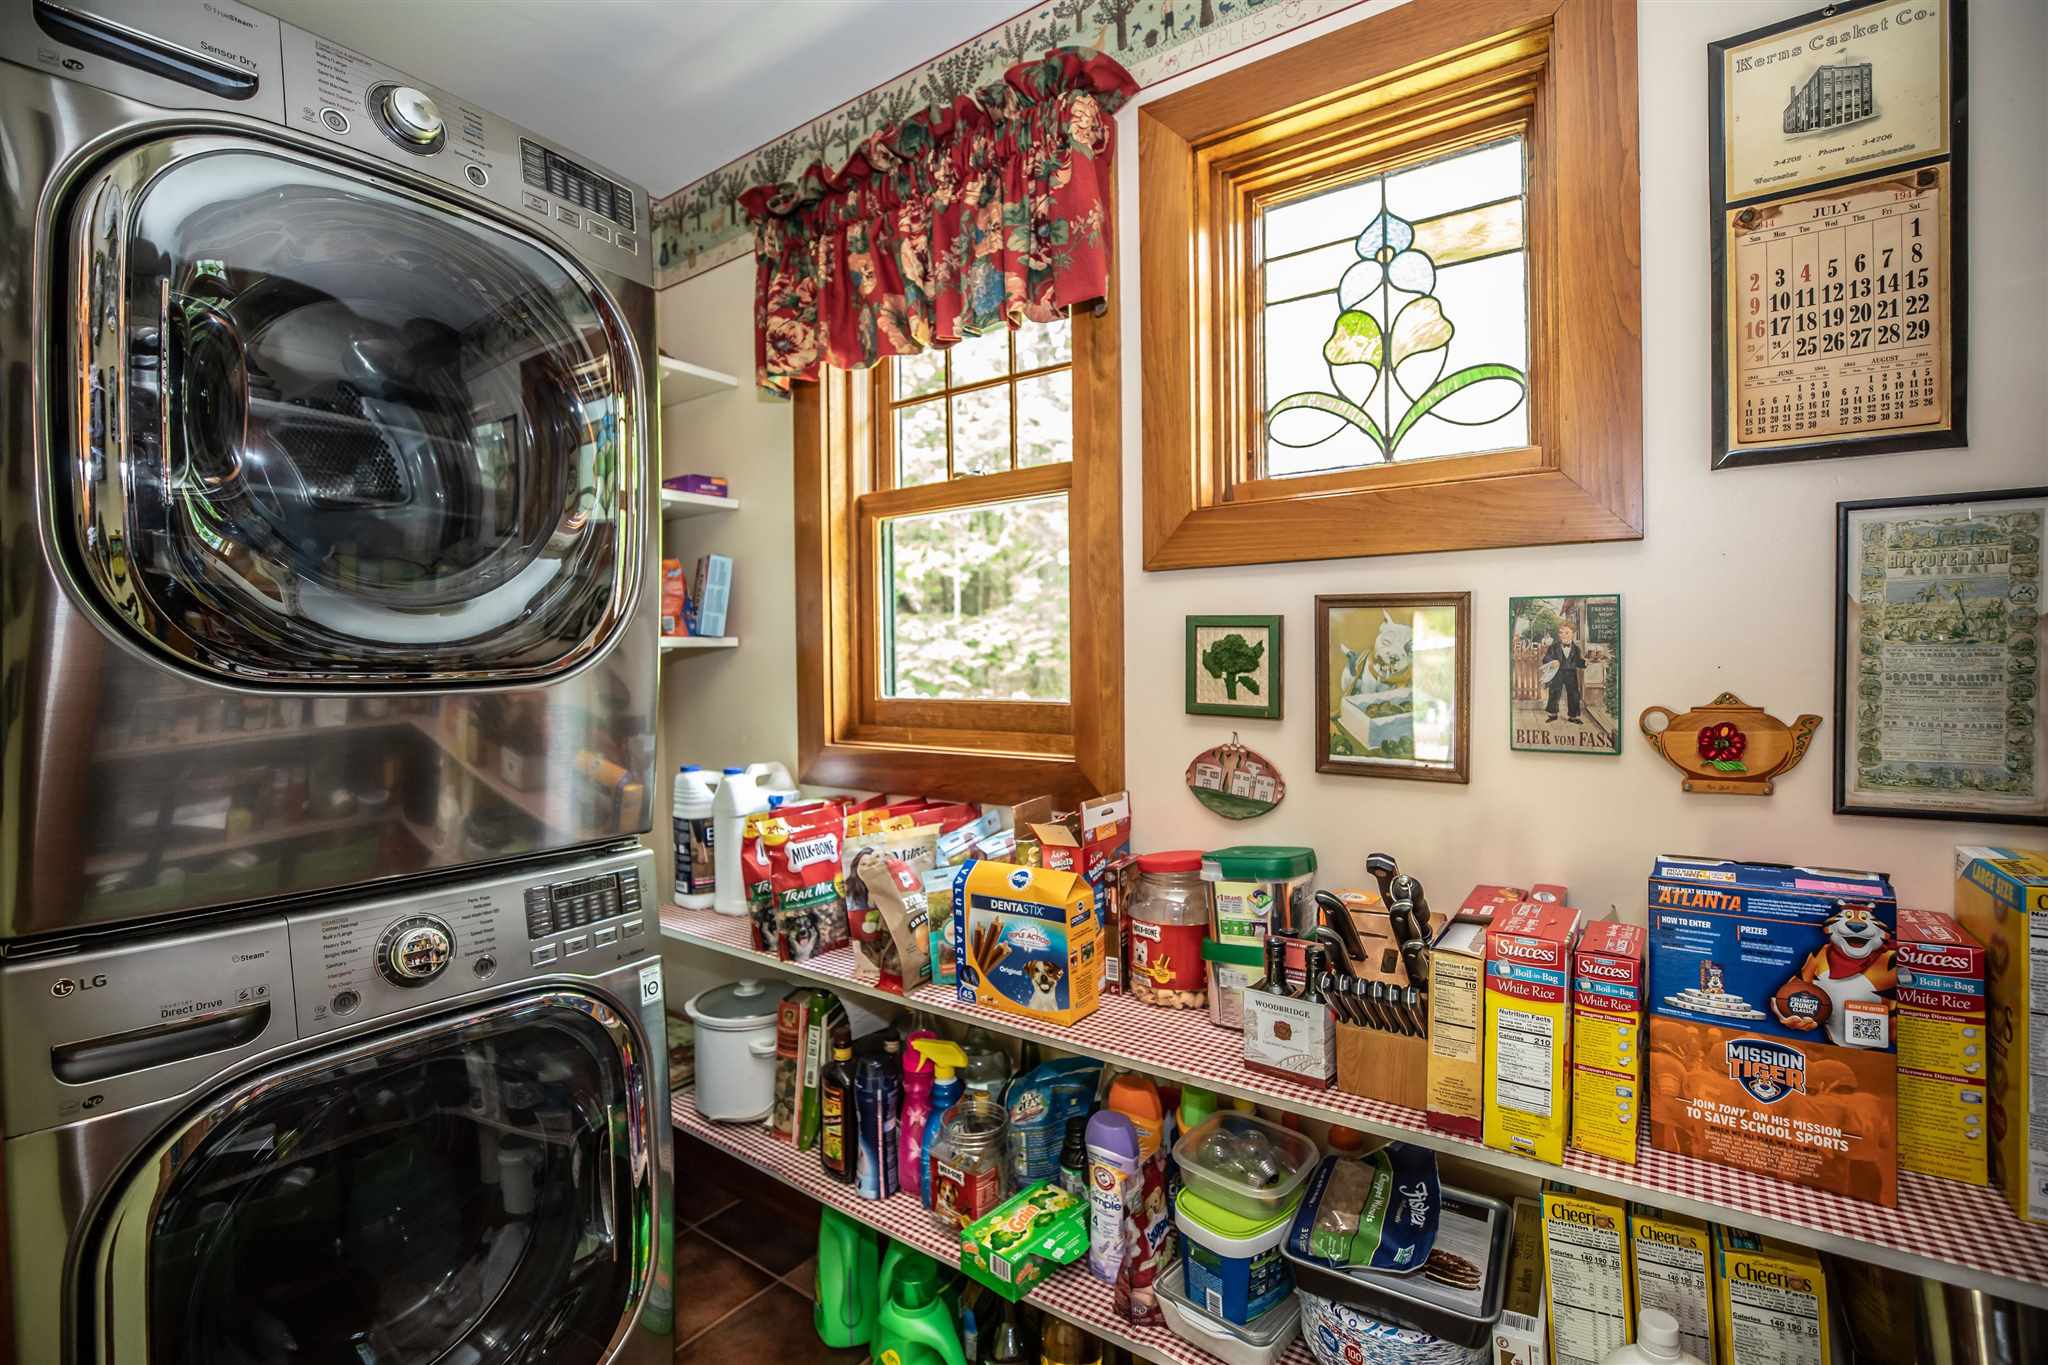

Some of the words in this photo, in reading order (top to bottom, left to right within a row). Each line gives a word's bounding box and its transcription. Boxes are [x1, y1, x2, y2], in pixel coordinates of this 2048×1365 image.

[1808, 17, 1889, 51] Casket
[1895, 8, 1936, 26] Co.
[200, 40, 237, 61] Sensor
[239, 54, 257, 71] Dry
[1799, 225, 1811, 233] Tue
[1824, 219, 1838, 228] Wed
[1852, 214, 1866, 222] Thu
[1881, 207, 1893, 216] Fri
[1908, 201, 1921, 210] Sat
[1812, 200, 1851, 219] JULY
[1911, 216, 1922, 237] 1
[1749, 273, 1760, 292] 2
[1775, 268, 1785, 287] 3
[1800, 263, 1812, 283] 4
[1827, 258, 1838, 278] 5
[1854, 253, 1866, 273] 6
[1881, 247, 1894, 269] 7
[1911, 242, 1923, 263] 8
[1749, 296, 1760, 316] 9
[1769, 291, 1791, 313] 10
[1795, 287, 1816, 308] 11
[1821, 282, 1844, 305] 12
[1848, 277, 1872, 299] 13
[1876, 272, 1900, 295] 14
[1904, 267, 1929, 290] 15
[1744, 319, 1766, 340] 16
[1769, 315, 1791, 337] 17
[1795, 311, 1817, 333] 18
[1822, 307, 1844, 329] 19
[1849, 302, 1872, 324] 20
[1877, 298, 1900, 320] 21
[1905, 293, 1930, 315] 22
[1796, 335, 1817, 357] 25
[1822, 332, 1845, 354] 26
[1849, 327, 1872, 349] 27
[1877, 323, 1901, 345] 28
[1906, 319, 1930, 341] 29
[1871, 354, 1898, 364] AUGUST
[1894, 381, 1904, 390] 10
[1909, 379, 1919, 388] 11
[1924, 377, 1933, 386] 12
[1910, 389, 1919, 398] 18
[1924, 387, 1934, 396] 19
[1516, 728, 1551, 745] BIER
[1554, 734, 1576, 747] VOM
[1579, 728, 1617, 750] FASS
[782, 888, 814, 903] TRAIL
[954, 868, 970, 917] VALUE
[1658, 888, 1742, 912] ATLANTA
[990, 898, 1044, 917] DENTASTIX
[1661, 915, 1678, 924] HOW
[1678, 918, 1688, 926] TO
[1689, 919, 1711, 929] ENTER
[1740, 925, 1768, 936] PRIZES
[955, 925, 964, 965] PACK
[1497, 938, 1556, 962] Success
[240, 952, 264, 963] Steam
[1896, 946, 1970, 969] Success
[1514, 967, 1559, 985] Boil-in-Bag
[1580, 959, 1631, 979] Success
[80, 974, 107, 991] LG
[1464, 981, 1477, 989] 110
[1496, 978, 1530, 996] White
[1532, 984, 1556, 1001] Rice
[1595, 983, 1634, 998] Boil-in-Bag
[1919, 976, 1976, 994] Boil-in-Bag
[160, 1004, 194, 1019] Direct
[195, 998, 224, 1012] Drive
[1255, 999, 1311, 1019] WOODBRIDGE
[1579, 993, 1609, 1008] White
[1610, 998, 1632, 1012] Rice
[1790, 1001, 1818, 1010] CRUNCH
[1897, 989, 1939, 1006] White
[1942, 994, 1971, 1010] Rice
[1498, 1007, 1530, 1020] Nutrition
[1531, 1013, 1552, 1024] Facts
[1931, 1012, 1967, 1023] Directions
[1533, 1037, 1551, 1047] 210
[1728, 1043, 1805, 1071] MISSION
[1728, 1058, 1806, 1092] TIGER
[1692, 1097, 1715, 1111] JOIN
[1718, 1103, 1746, 1117] TONY
[1752, 1111, 1768, 1123] ON
[1771, 1116, 1790, 1128] HIS
[1792, 1120, 1842, 1138] MISSION
[1686, 1106, 1701, 1119] TO
[1704, 1110, 1737, 1128] SAVE
[1740, 1118, 1793, 1140] SCHOOL
[1795, 1131, 1849, 1152] SPORTS
[1399, 1181, 1430, 1228] Fisher
[1007, 1203, 1040, 1233] Gain
[1551, 1202, 1616, 1230] Cheerios
[1640, 1224, 1697, 1249] Cheerios
[1580, 1253, 1593, 1263] 140
[1594, 1256, 1607, 1265] 190
[1611, 1259, 1620, 1267] 70
[1667, 1273, 1679, 1282] 140
[1734, 1261, 1813, 1293] Cheerios
[1769, 1318, 1785, 1329] 140
[1787, 1321, 1802, 1332] 190
[1807, 1326, 1818, 1335] 70
[1346, 1347, 1362, 1362] 100
